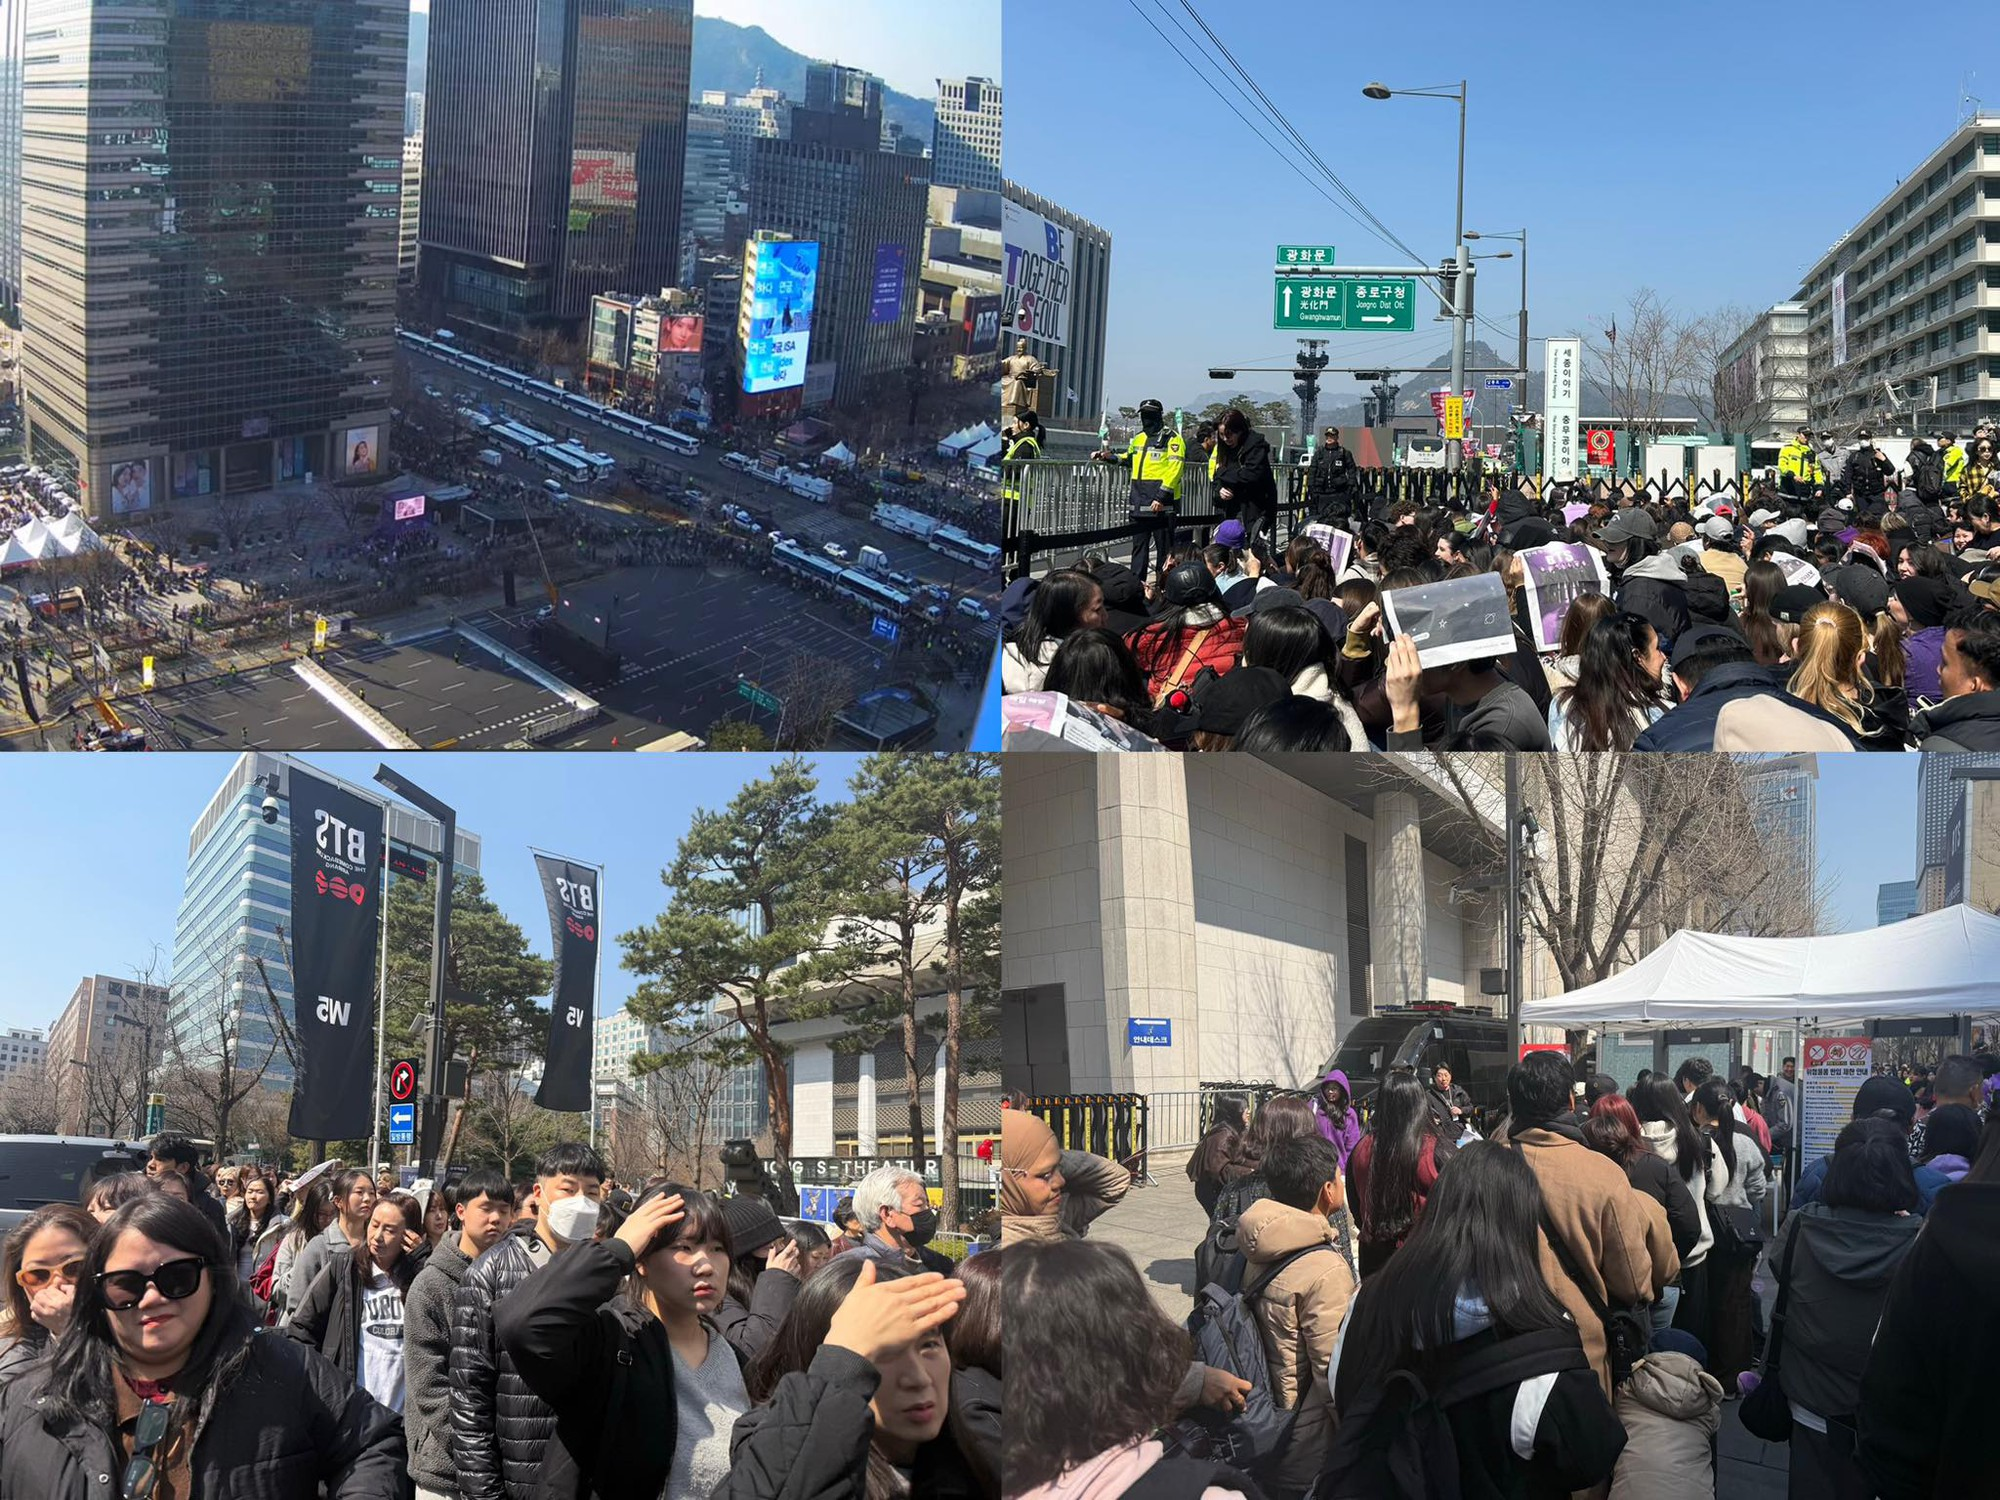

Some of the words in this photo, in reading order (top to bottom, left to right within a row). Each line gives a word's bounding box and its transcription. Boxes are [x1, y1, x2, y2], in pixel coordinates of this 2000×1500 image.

[1044, 222, 1064, 265] BE
[1286, 249, 1325, 262] 광화문
[1005, 243, 1069, 305] TOGETHER
[1300, 286, 1337, 299] 광화문
[1355, 286, 1405, 299] 종로구청
[1300, 300, 1328, 310] 光化門
[1356, 301, 1377, 311] Jongno
[1017, 292, 1060, 341] SEOUL
[1299, 312, 1342, 322] Gwanghwamun
[974, 311, 998, 342] BTS
[1133, 1036, 1168, 1044] 안내데스크
[1856, 1068, 1868, 1076] 안내
